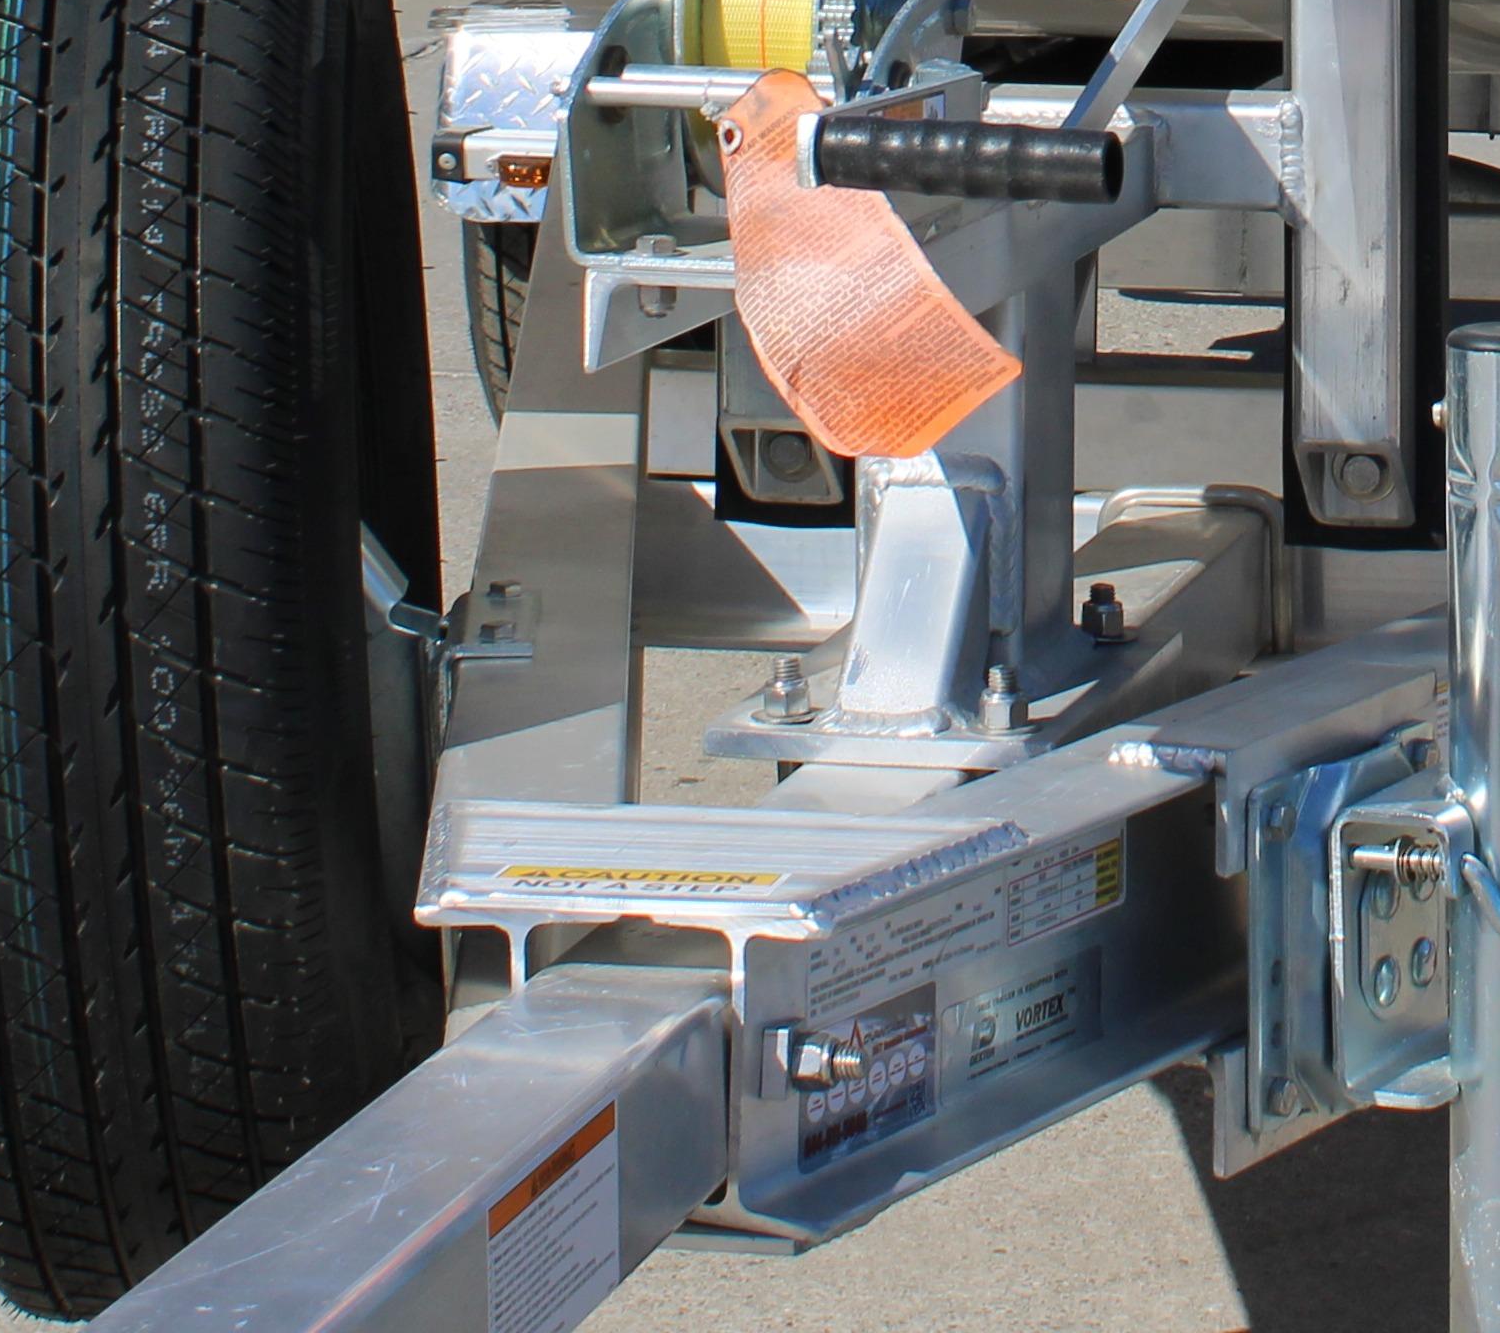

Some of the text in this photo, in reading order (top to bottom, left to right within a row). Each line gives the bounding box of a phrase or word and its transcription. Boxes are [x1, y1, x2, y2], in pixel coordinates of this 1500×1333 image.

[566, 869, 758, 884] CAUTION
[512, 878, 742, 893] NOT A STEP
[1015, 992, 1065, 1031] VORTEX
